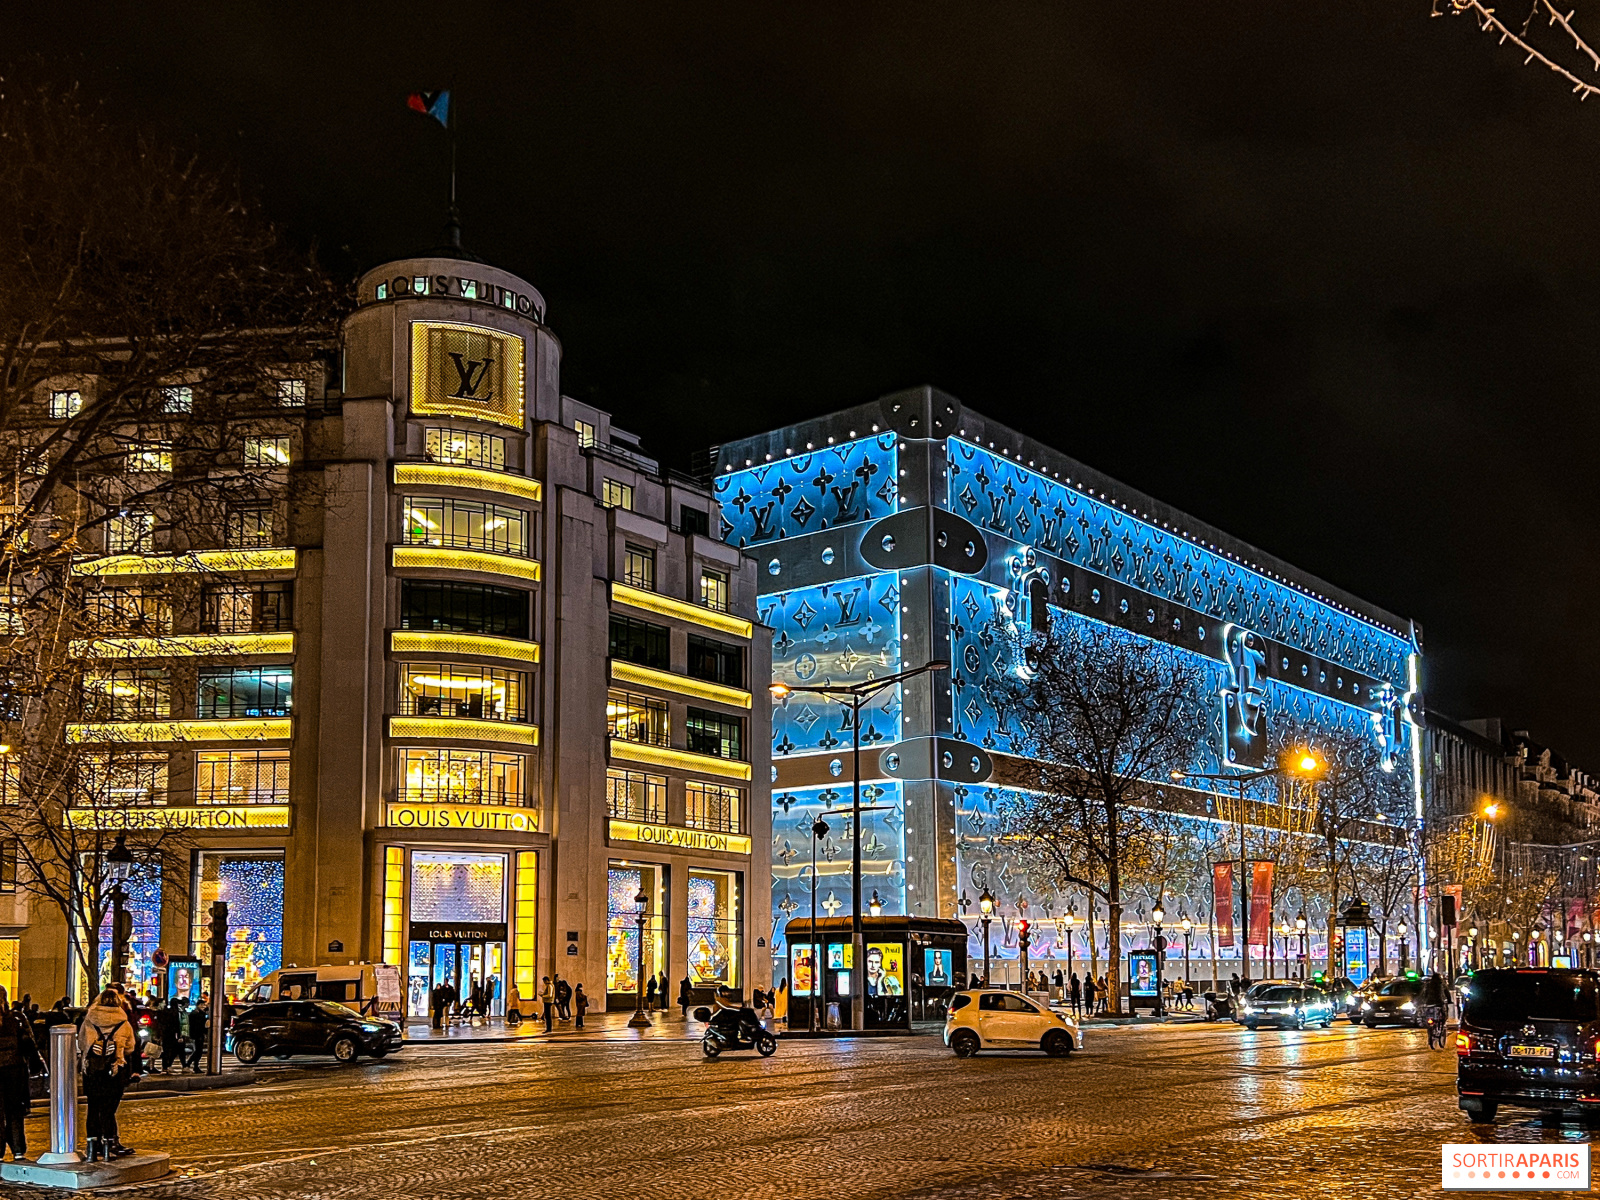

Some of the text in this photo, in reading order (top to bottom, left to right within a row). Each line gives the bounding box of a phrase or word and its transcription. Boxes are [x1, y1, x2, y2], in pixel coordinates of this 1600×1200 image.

[384, 275, 543, 323] LOUIS VUITTON
[447, 352, 494, 402] LV
[104, 810, 247, 828] LOUIS VUITTON
[390, 810, 539, 831] LOUIS VUITTON
[637, 825, 728, 850] LOUIS VUITTON
[429, 930, 488, 938] LOUIS VUITTON
